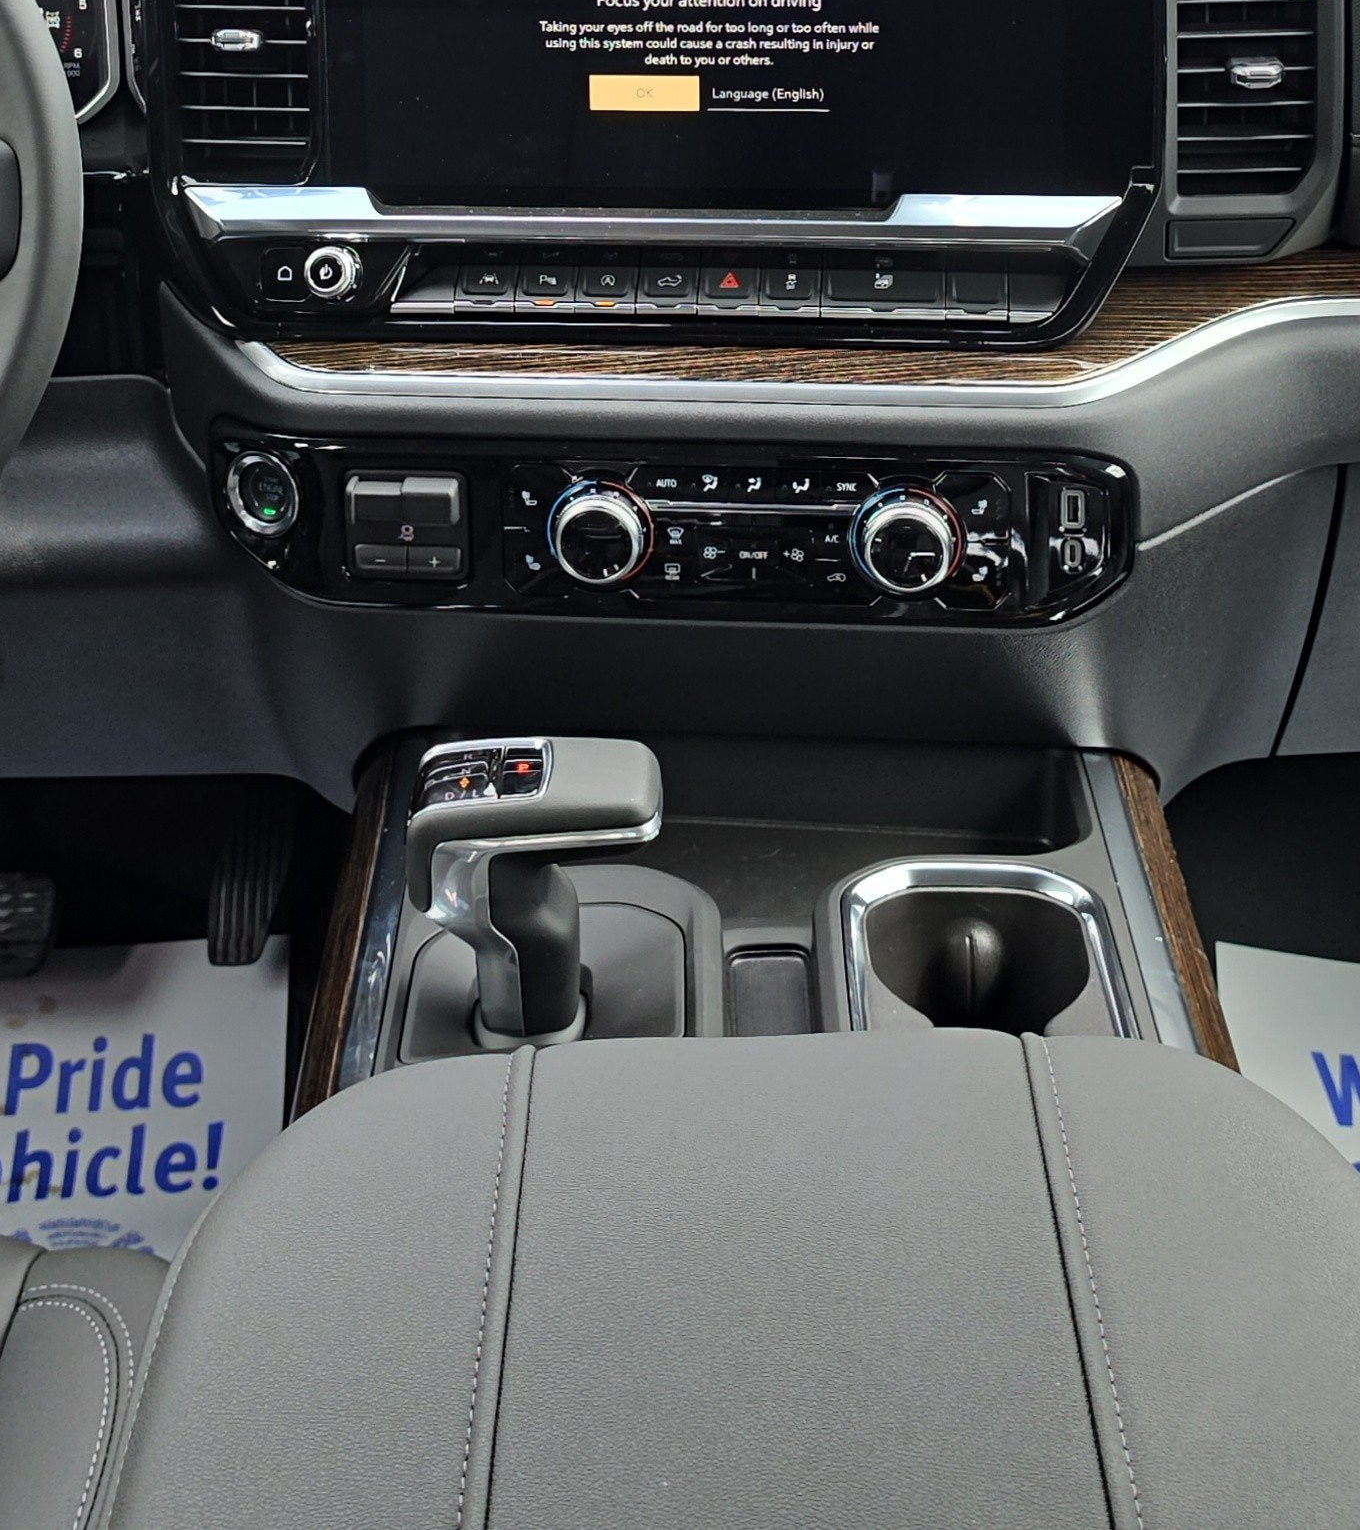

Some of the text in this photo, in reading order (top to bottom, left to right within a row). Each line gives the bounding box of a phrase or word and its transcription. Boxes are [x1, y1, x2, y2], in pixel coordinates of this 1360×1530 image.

[78, 0, 87, 10] 5
[539, 21, 880, 35] Taking your eyes off the road for too long or too often while
[545, 37, 875, 52] using this system could cause a crash resulting in injury or
[73, 48, 83, 59] 6
[644, 53, 774, 68] death to you or others.
[636, 88, 654, 99] OK
[712, 87, 825, 101] Language (English)
[655, 478, 677, 488] AUTO
[837, 482, 857, 492] SYNC
[824, 535, 840, 544] A/C
[739, 551, 769, 560] ON/OFF
[4, 1032, 205, 1116] Pride
